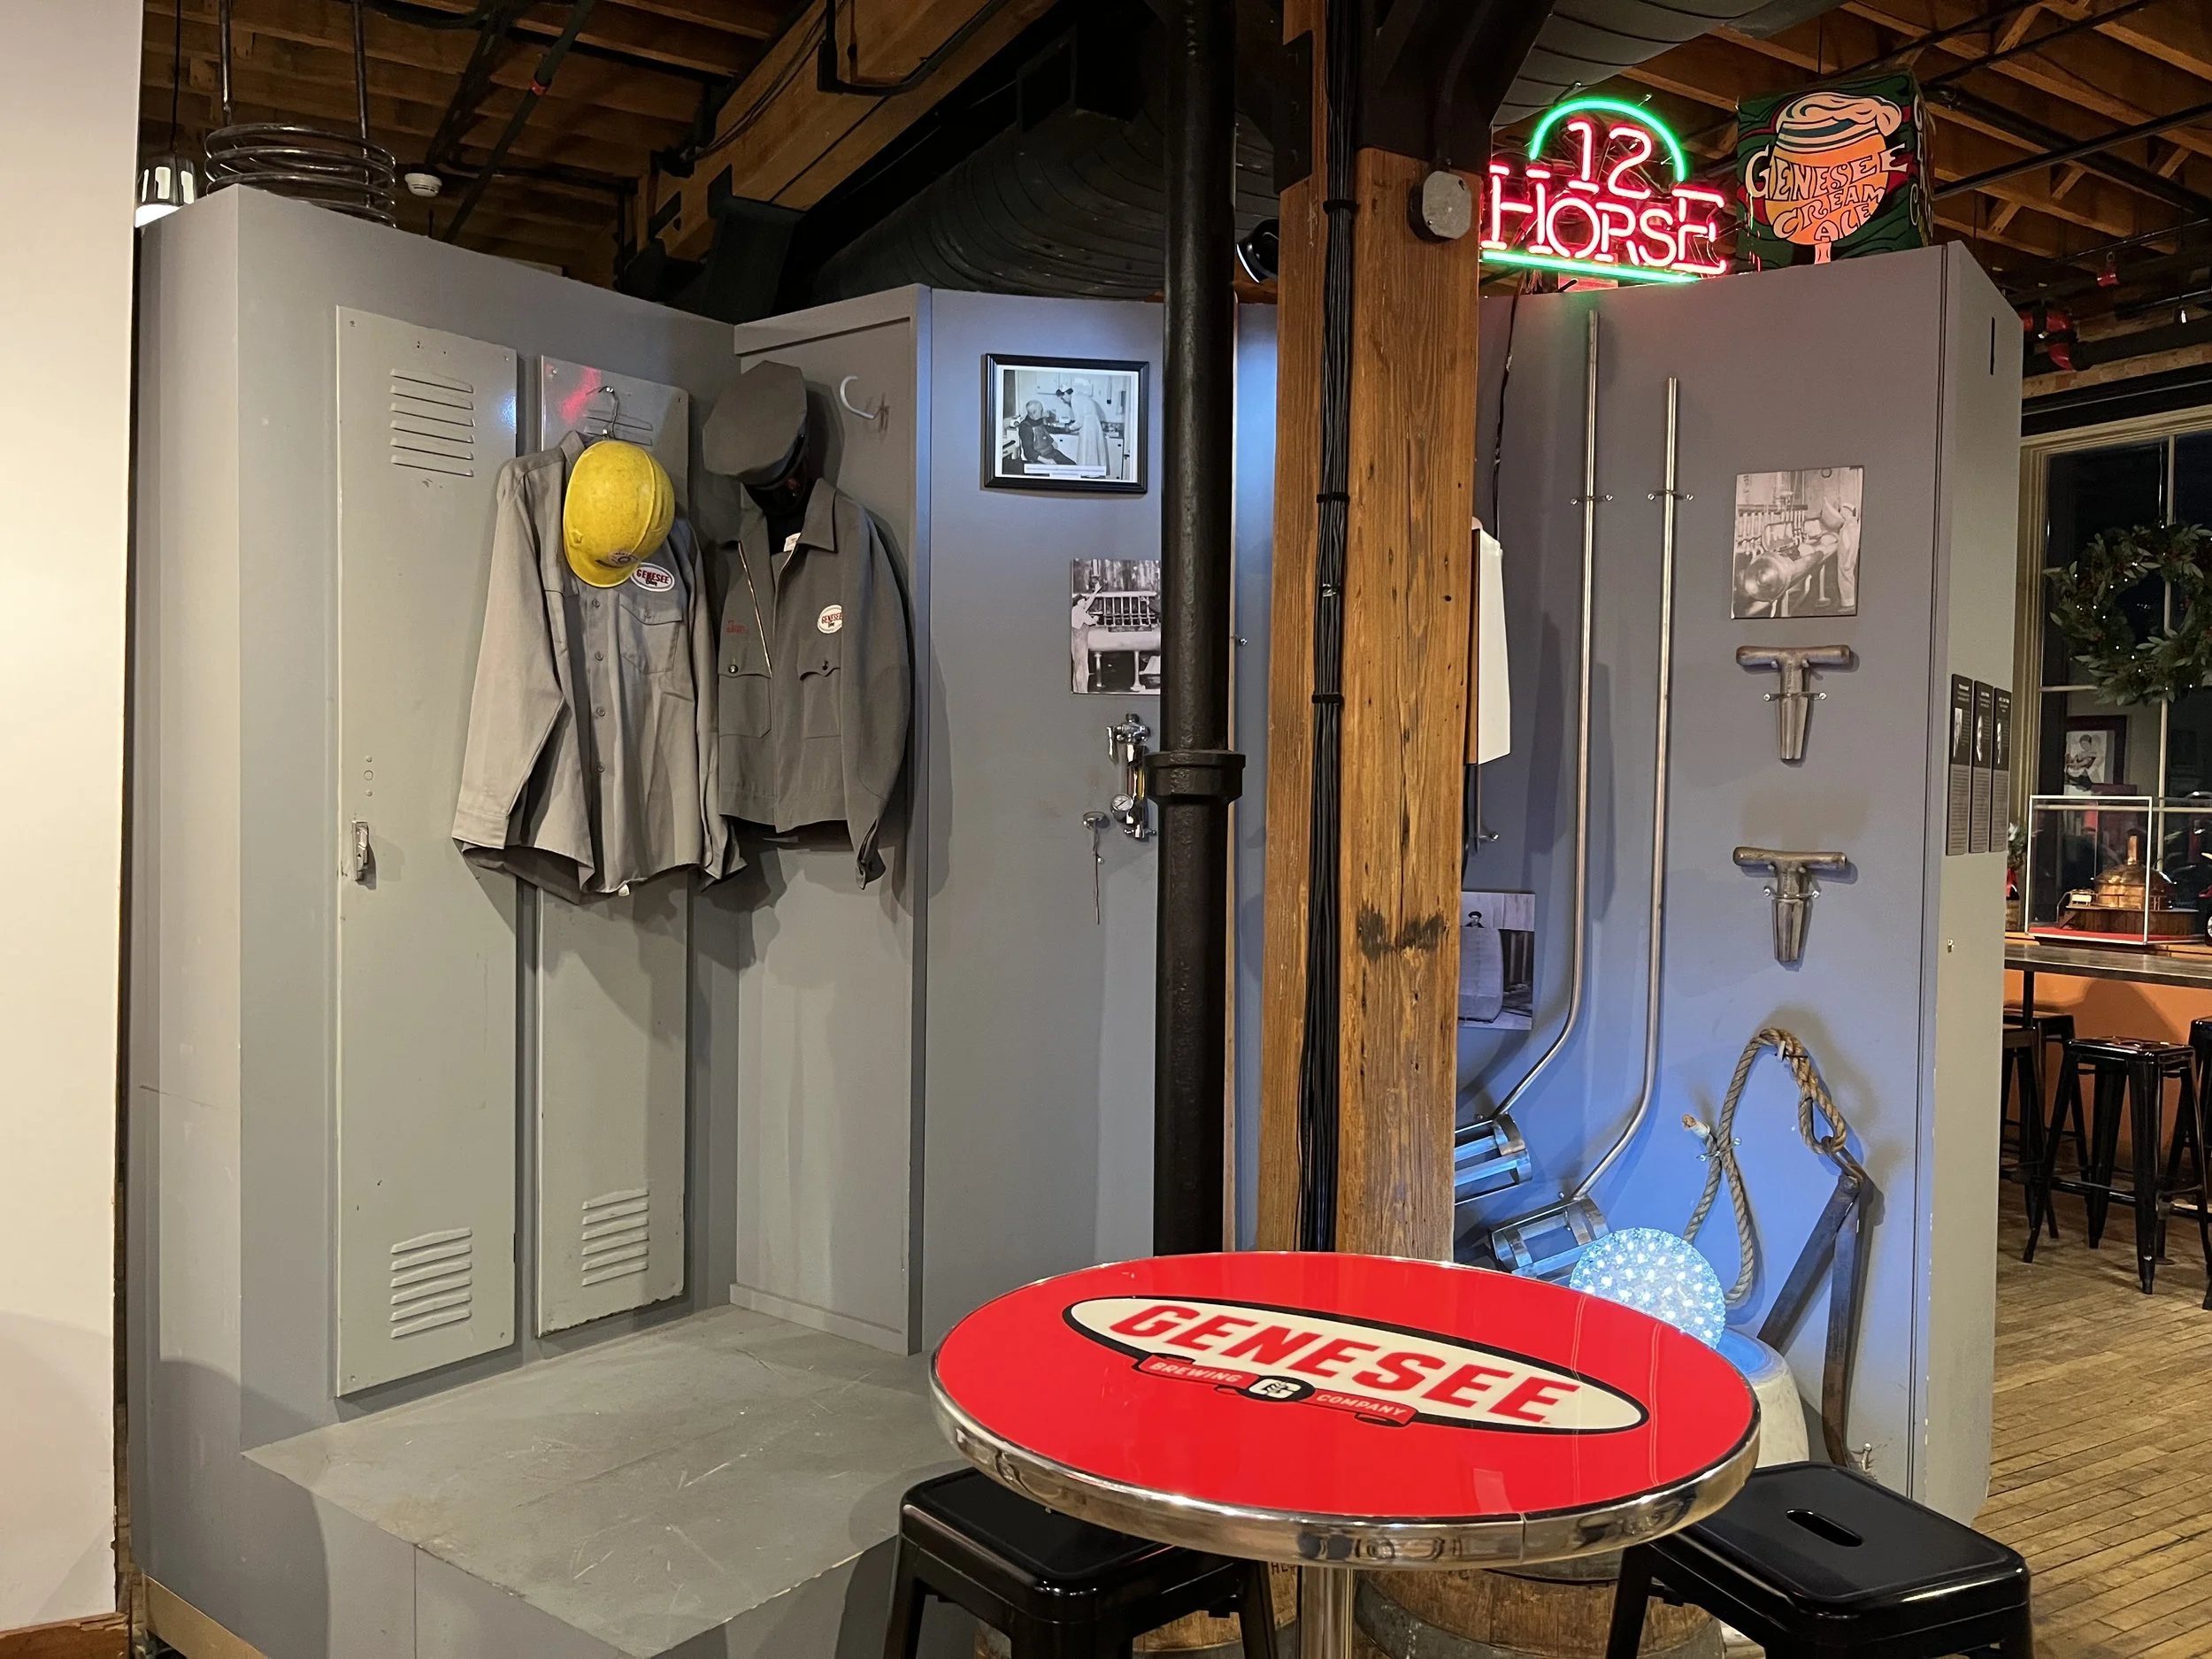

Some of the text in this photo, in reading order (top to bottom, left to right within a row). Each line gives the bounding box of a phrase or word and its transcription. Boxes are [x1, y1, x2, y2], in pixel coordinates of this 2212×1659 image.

[1566, 116, 1654, 200] 12
[1745, 142, 1909, 203] GENESEE
[1479, 165, 1727, 274] HORSE
[1772, 183, 1886, 239] CREAM
[1813, 202, 1873, 242] ALE
[636, 569, 670, 584] GENESEE
[1108, 1304, 1581, 1424] GENESEE
[1148, 1361, 1244, 1384] BREWING
[1316, 1393, 1409, 1417] COMPANY
